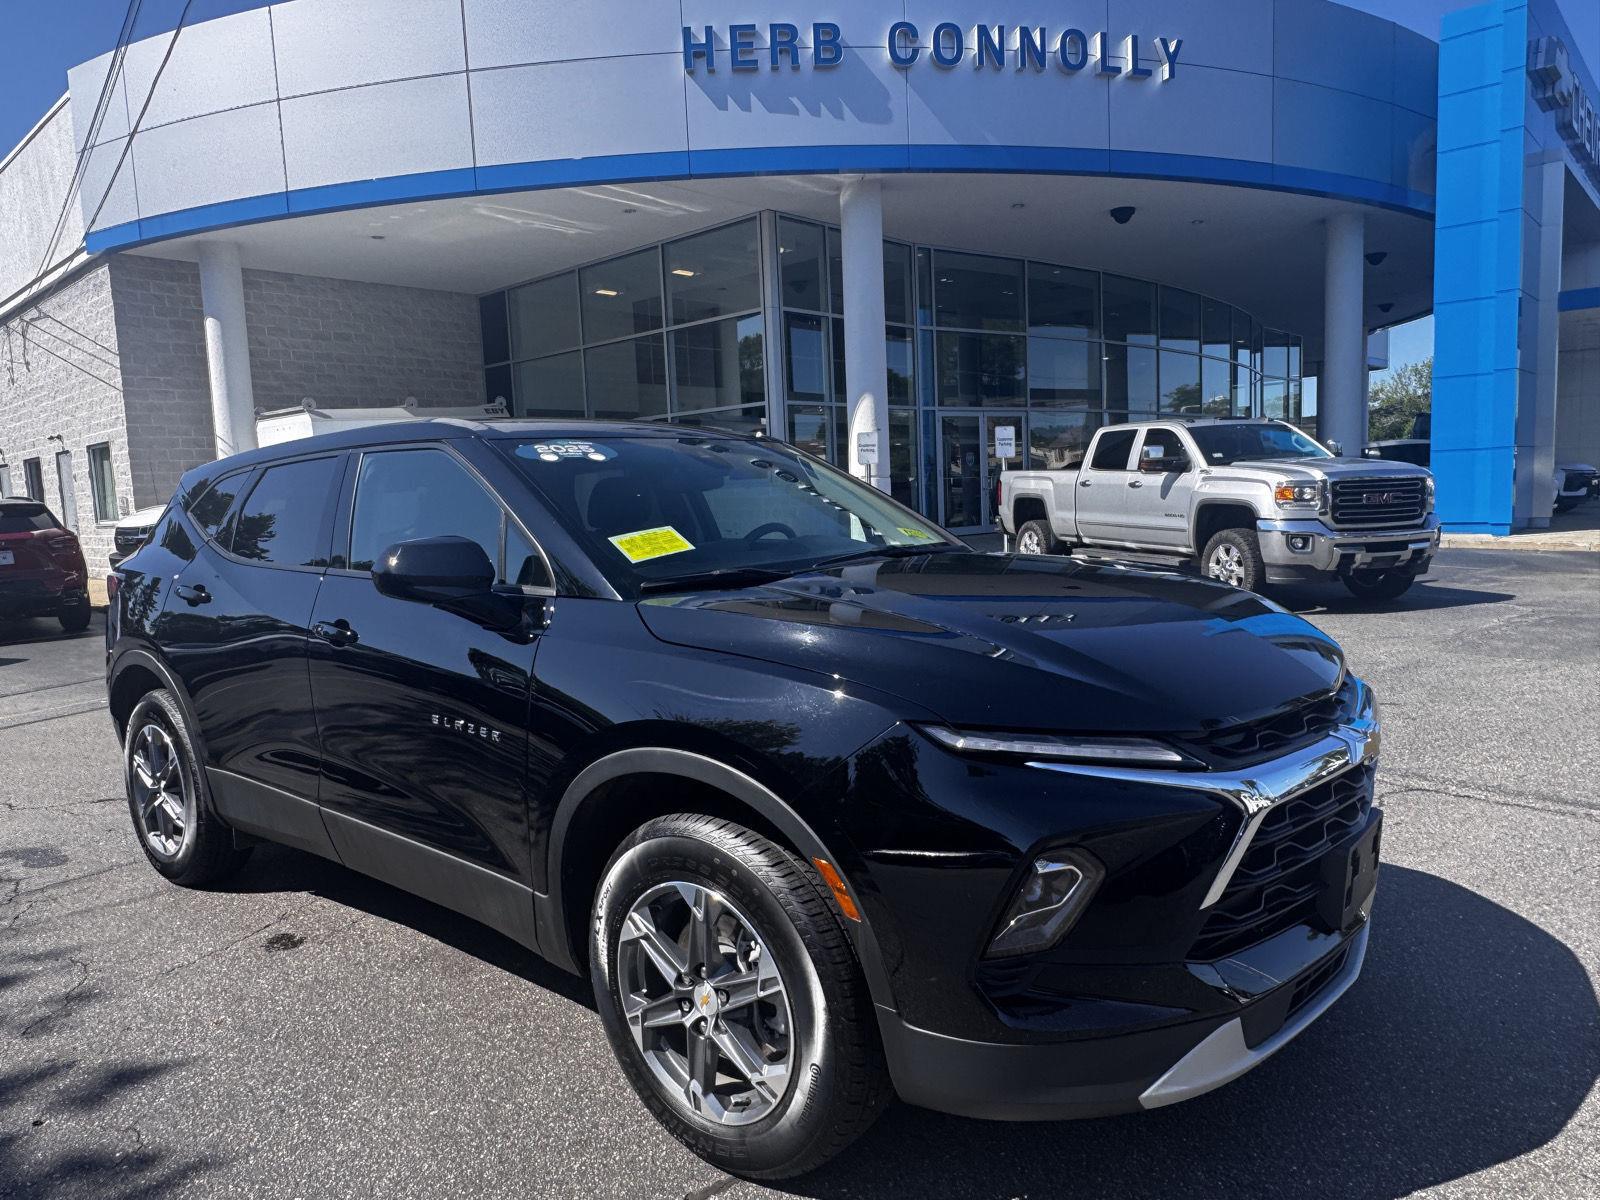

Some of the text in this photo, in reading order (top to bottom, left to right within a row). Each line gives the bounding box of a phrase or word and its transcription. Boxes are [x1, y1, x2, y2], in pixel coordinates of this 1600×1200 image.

[683, 21, 1184, 81] HERB CONNOLLY
[534, 444, 596, 453] 2025
[1362, 492, 1403, 505] GMC
[431, 713, 501, 742] BLAZER
[598, 881, 613, 911] SPORT
[800, 1062, 822, 1122] Continental
